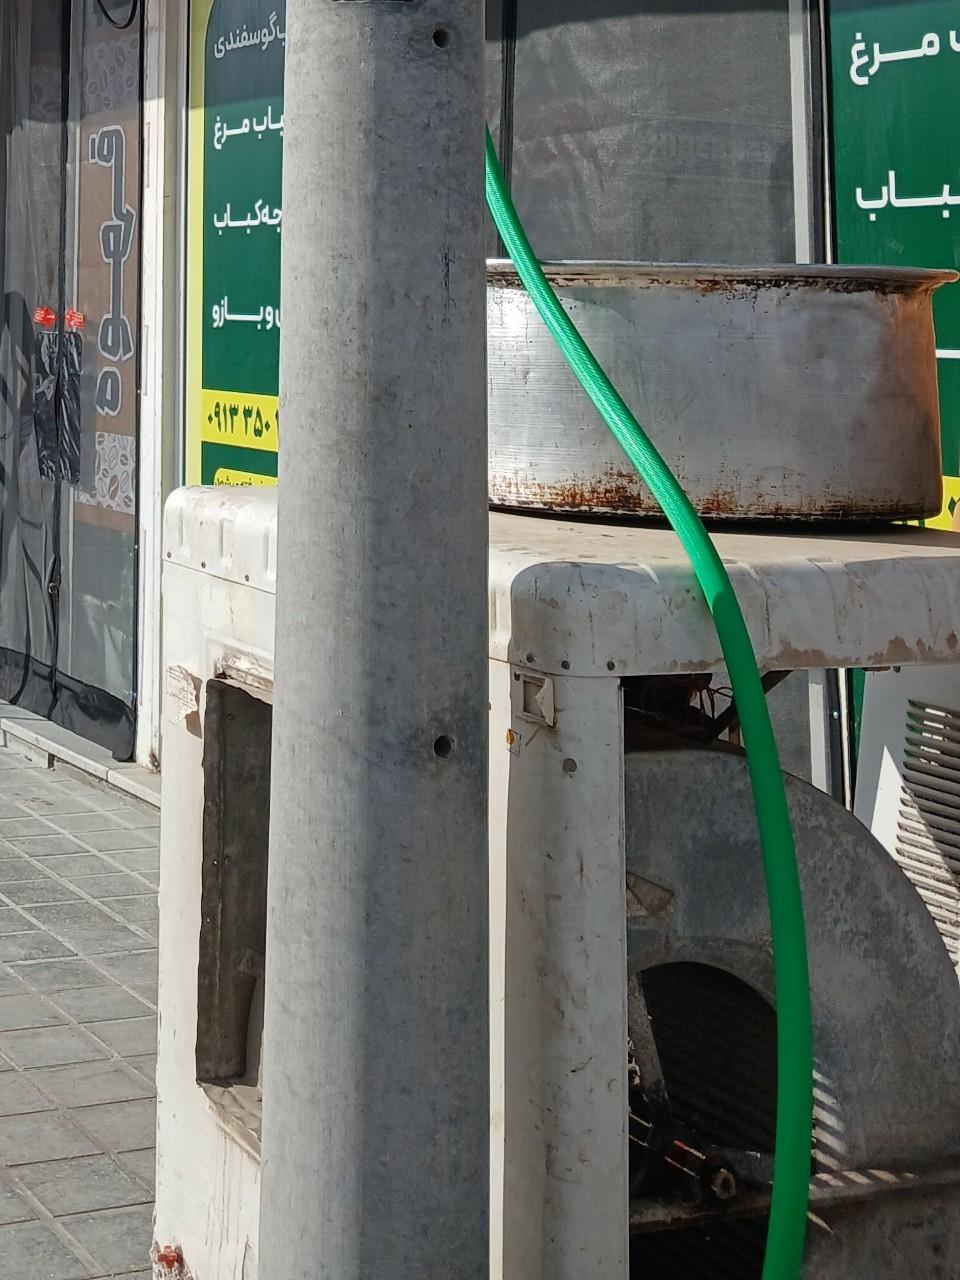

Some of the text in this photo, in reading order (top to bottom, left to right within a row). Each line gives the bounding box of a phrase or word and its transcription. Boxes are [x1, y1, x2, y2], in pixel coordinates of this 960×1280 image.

[214, 11, 278, 59] گوسفندی
[850, 32, 940, 86] مرغ
[213, 106, 285, 150] باب مرغ
[855, 170, 960, 221] باب
[212, 296, 264, 330] بازو
